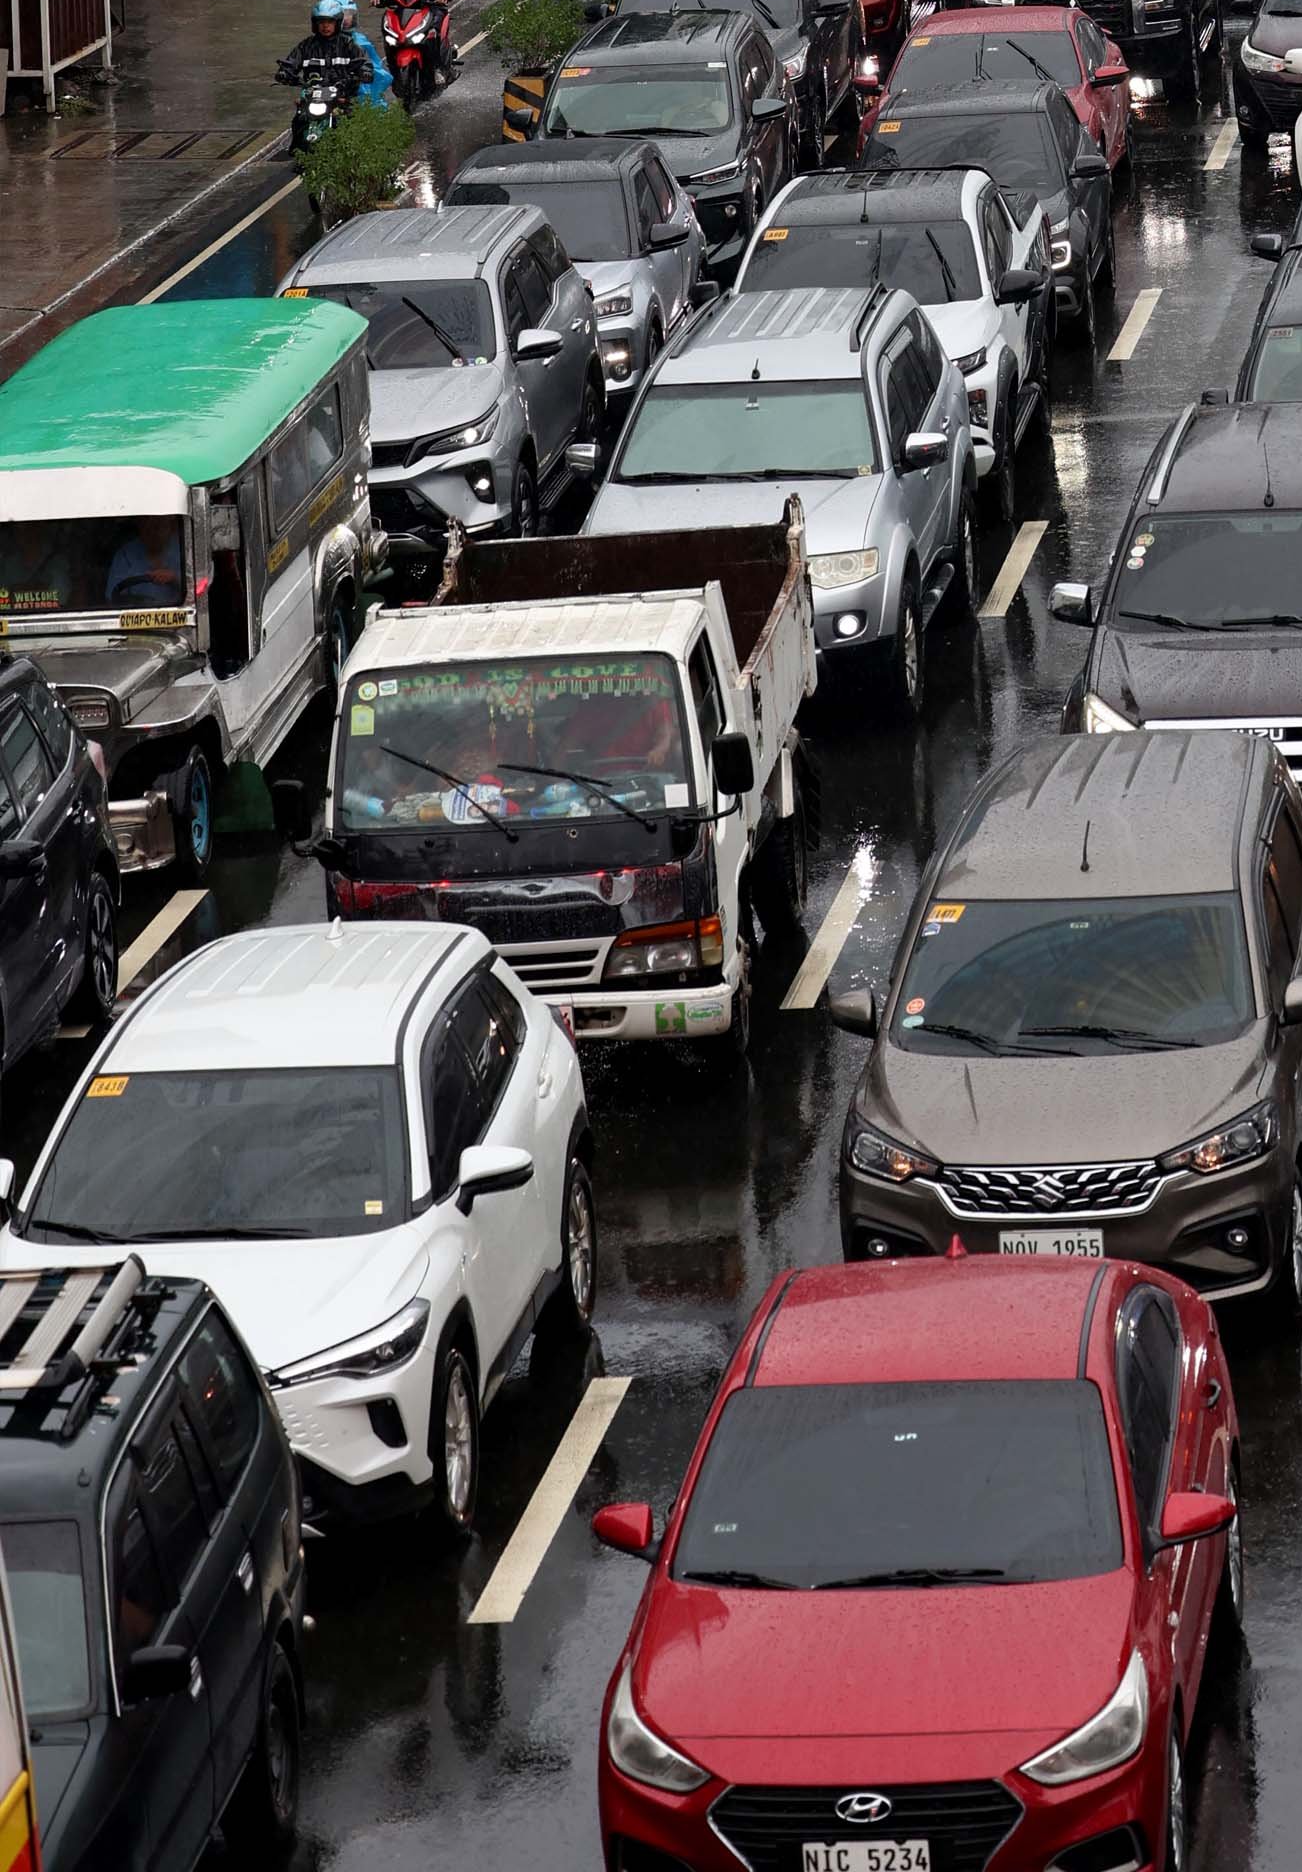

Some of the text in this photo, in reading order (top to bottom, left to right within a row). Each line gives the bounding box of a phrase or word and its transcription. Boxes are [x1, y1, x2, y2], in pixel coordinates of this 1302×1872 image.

[14, 591, 59, 602] WELCOME
[120, 611, 187, 628] QUIAPO-KALAW
[1053, 1238, 1101, 1257] 1955
[806, 1847, 929, 1872] NIC 5234
